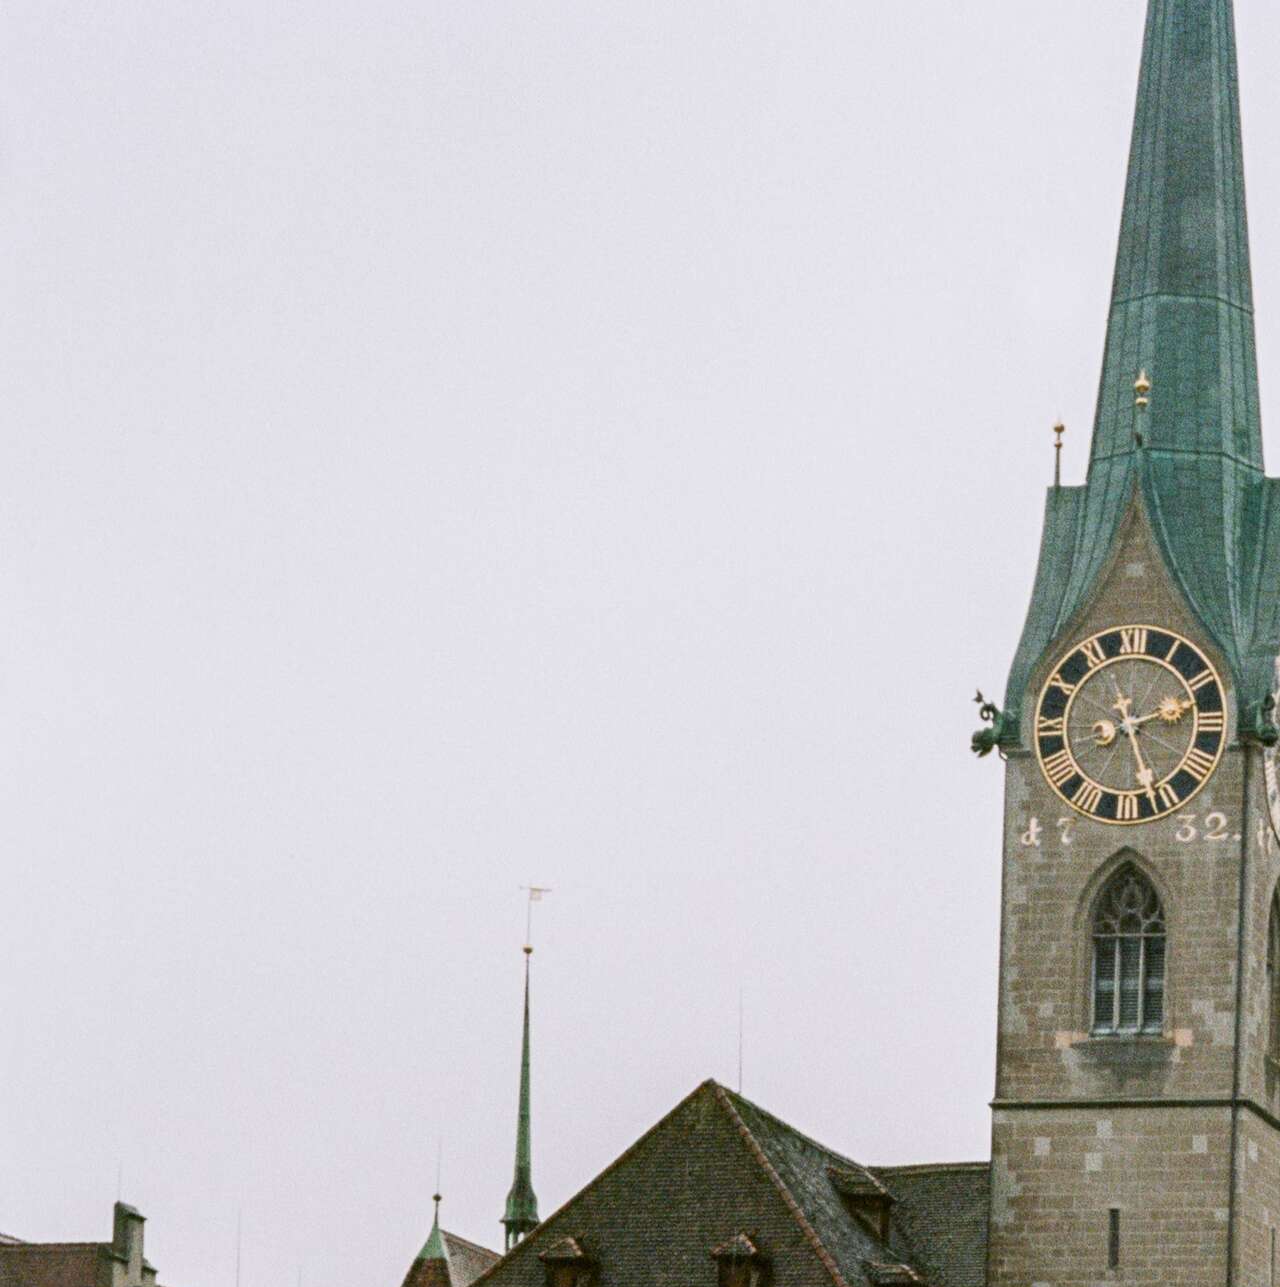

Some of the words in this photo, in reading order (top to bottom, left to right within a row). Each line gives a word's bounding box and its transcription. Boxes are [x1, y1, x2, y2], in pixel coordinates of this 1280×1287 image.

[1120, 628, 1147, 654] XII
[1165, 638, 1182, 662] I
[1079, 638, 1106, 669] XI
[1049, 672, 1075, 695] X
[1187, 668, 1214, 691] II
[1198, 711, 1223, 732] III
[1181, 747, 1215, 780] IIII
